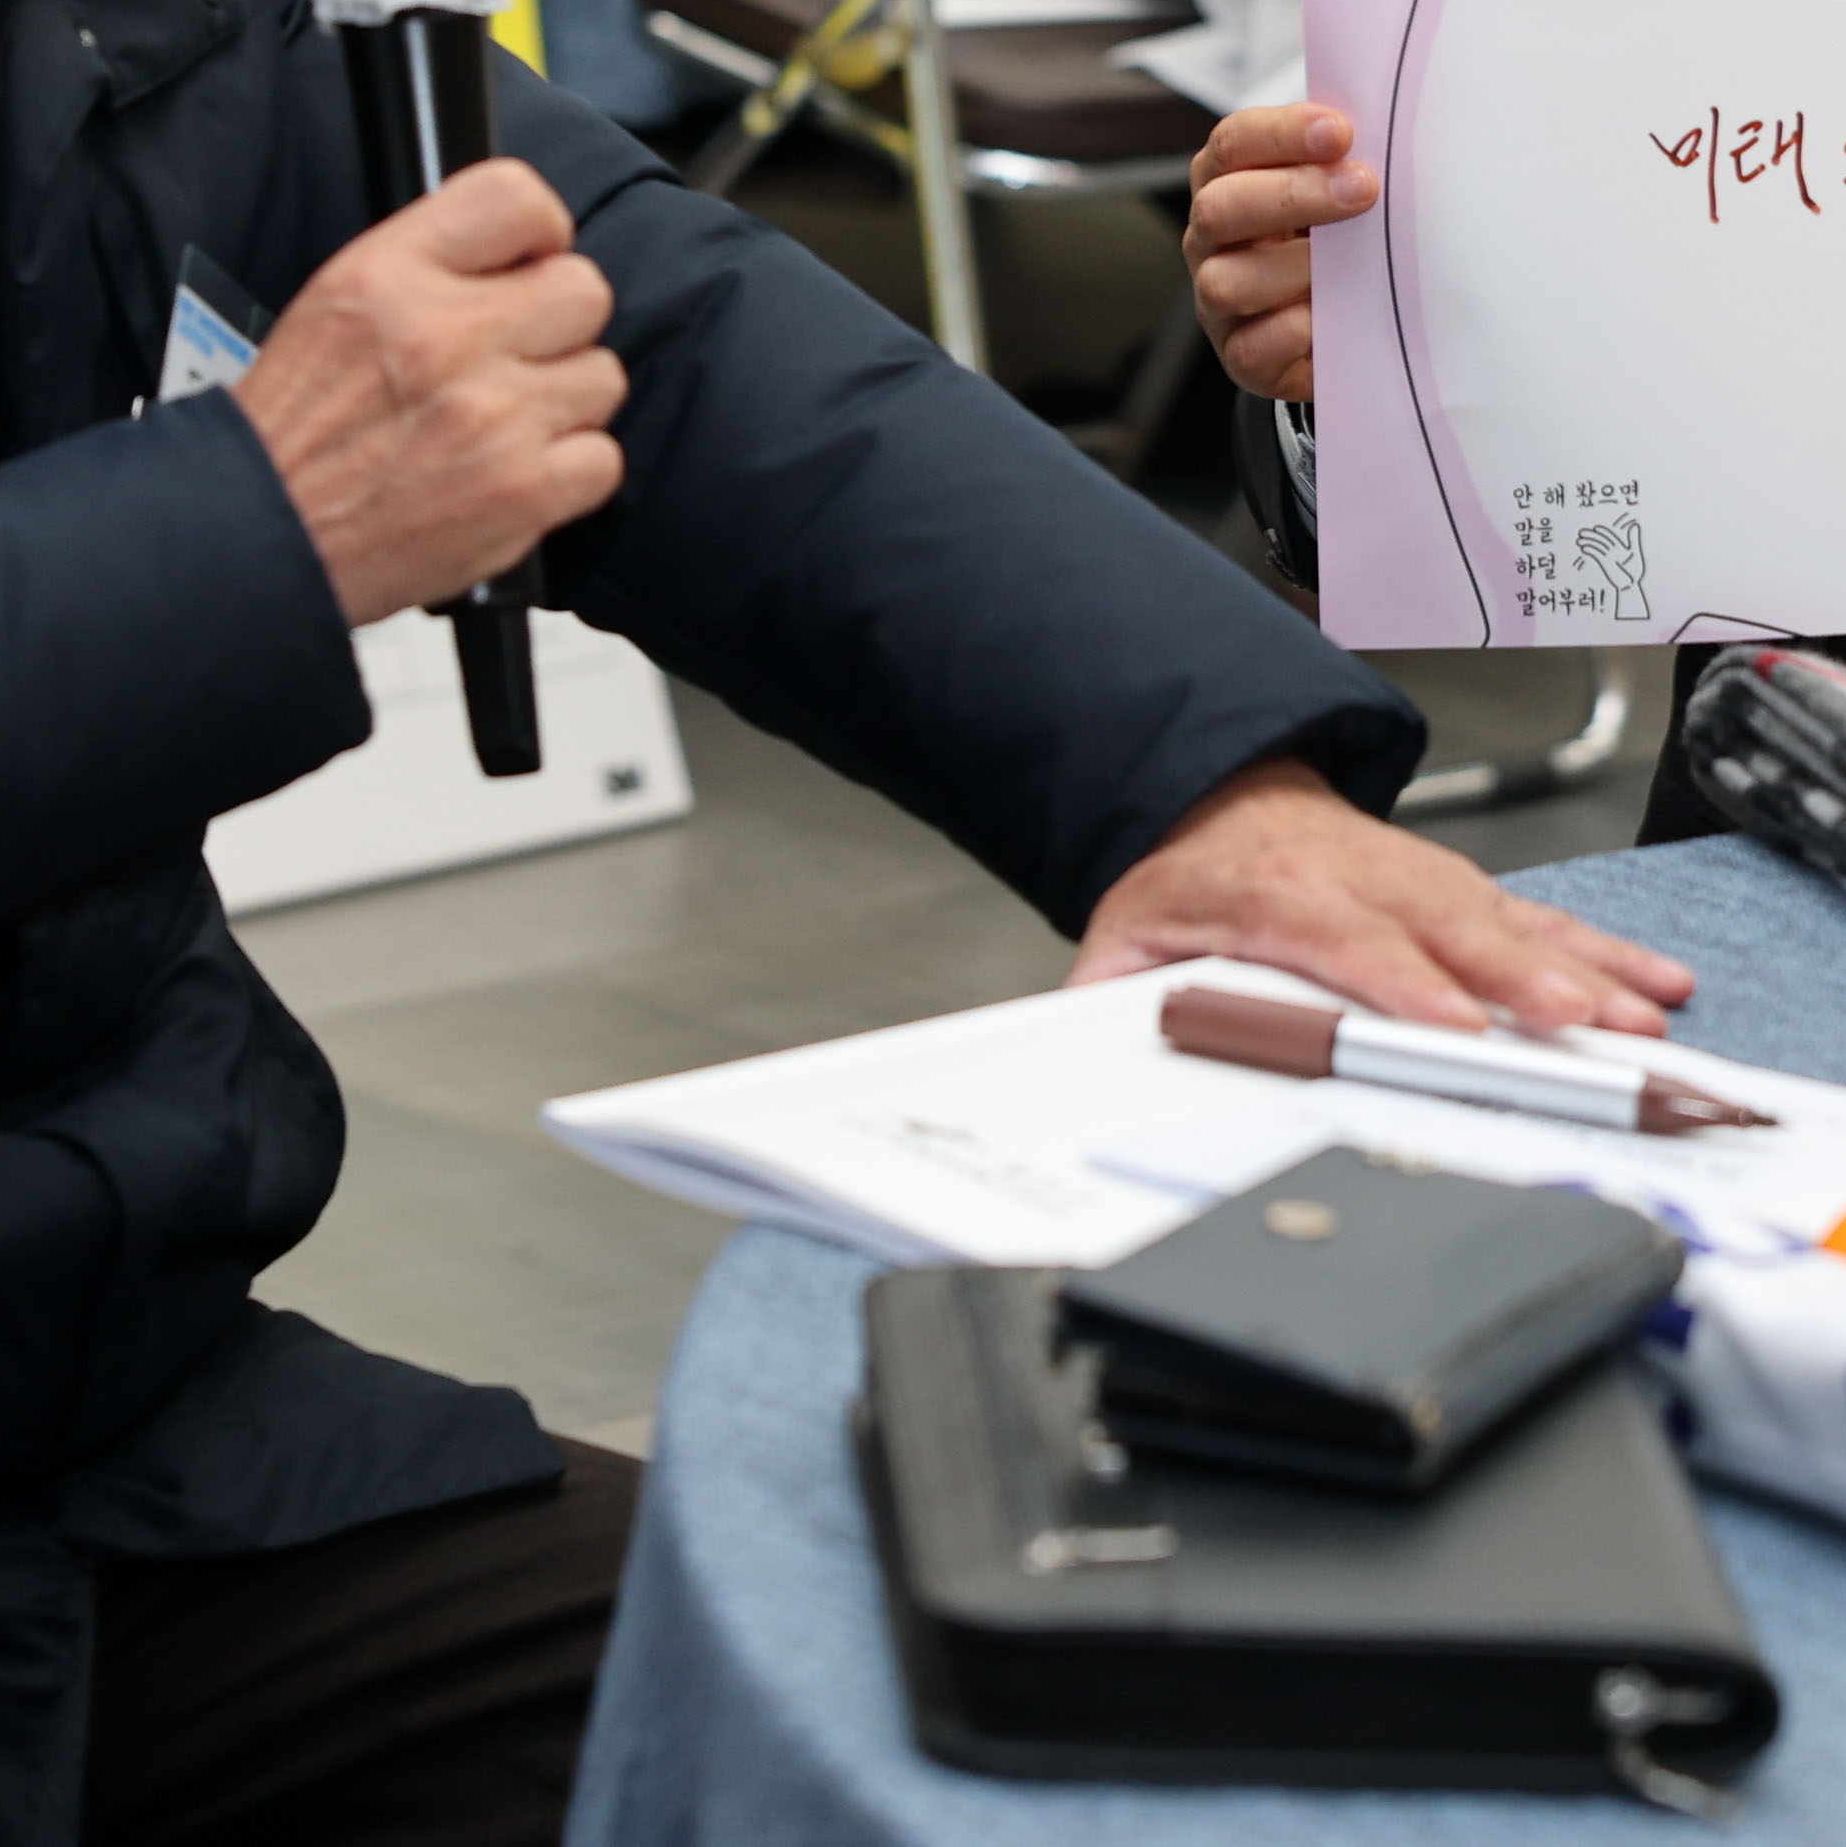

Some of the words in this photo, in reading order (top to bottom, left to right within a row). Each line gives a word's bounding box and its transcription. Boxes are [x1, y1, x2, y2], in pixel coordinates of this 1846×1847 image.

[1513, 483, 1533, 509] 안
[1543, 482, 1564, 508] 해
[1576, 479, 1639, 508] 봤으면
[1514, 517, 1553, 546] 말을
[1515, 551, 1556, 580] 하덜
[1516, 587, 1605, 616] 말어부러!
